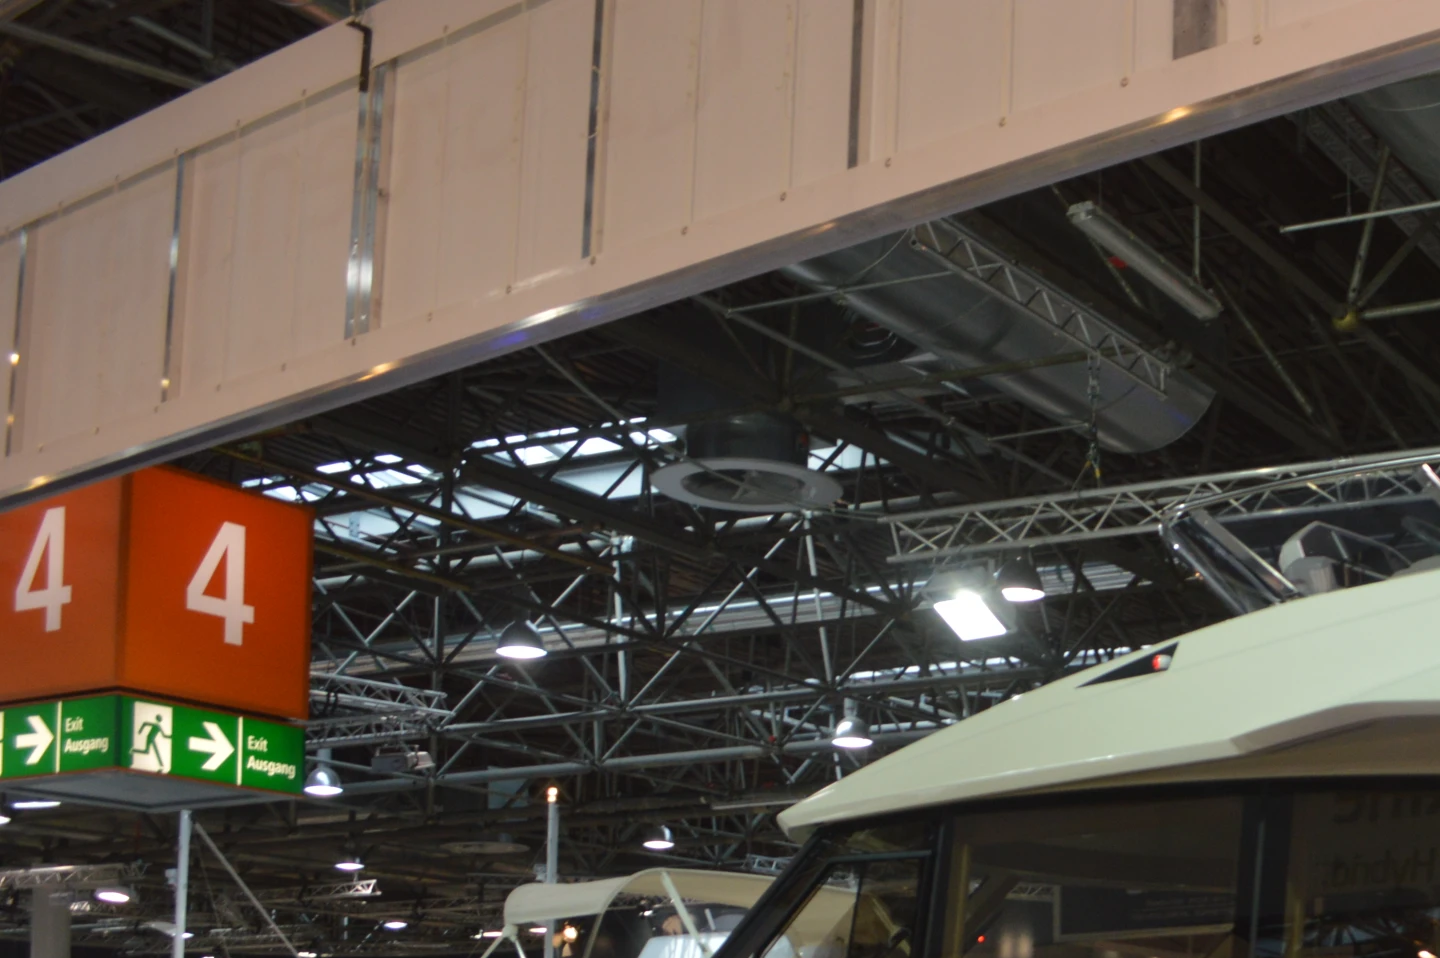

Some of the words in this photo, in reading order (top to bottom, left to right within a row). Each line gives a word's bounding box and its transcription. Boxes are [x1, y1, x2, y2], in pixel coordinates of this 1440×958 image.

[15, 506, 72, 633] 4
[186, 520, 255, 646] 4
[65, 716, 84, 733] Exit
[64, 736, 109, 756] Ausgang
[247, 735, 268, 752] Exit
[246, 755, 297, 780] Ausgang
